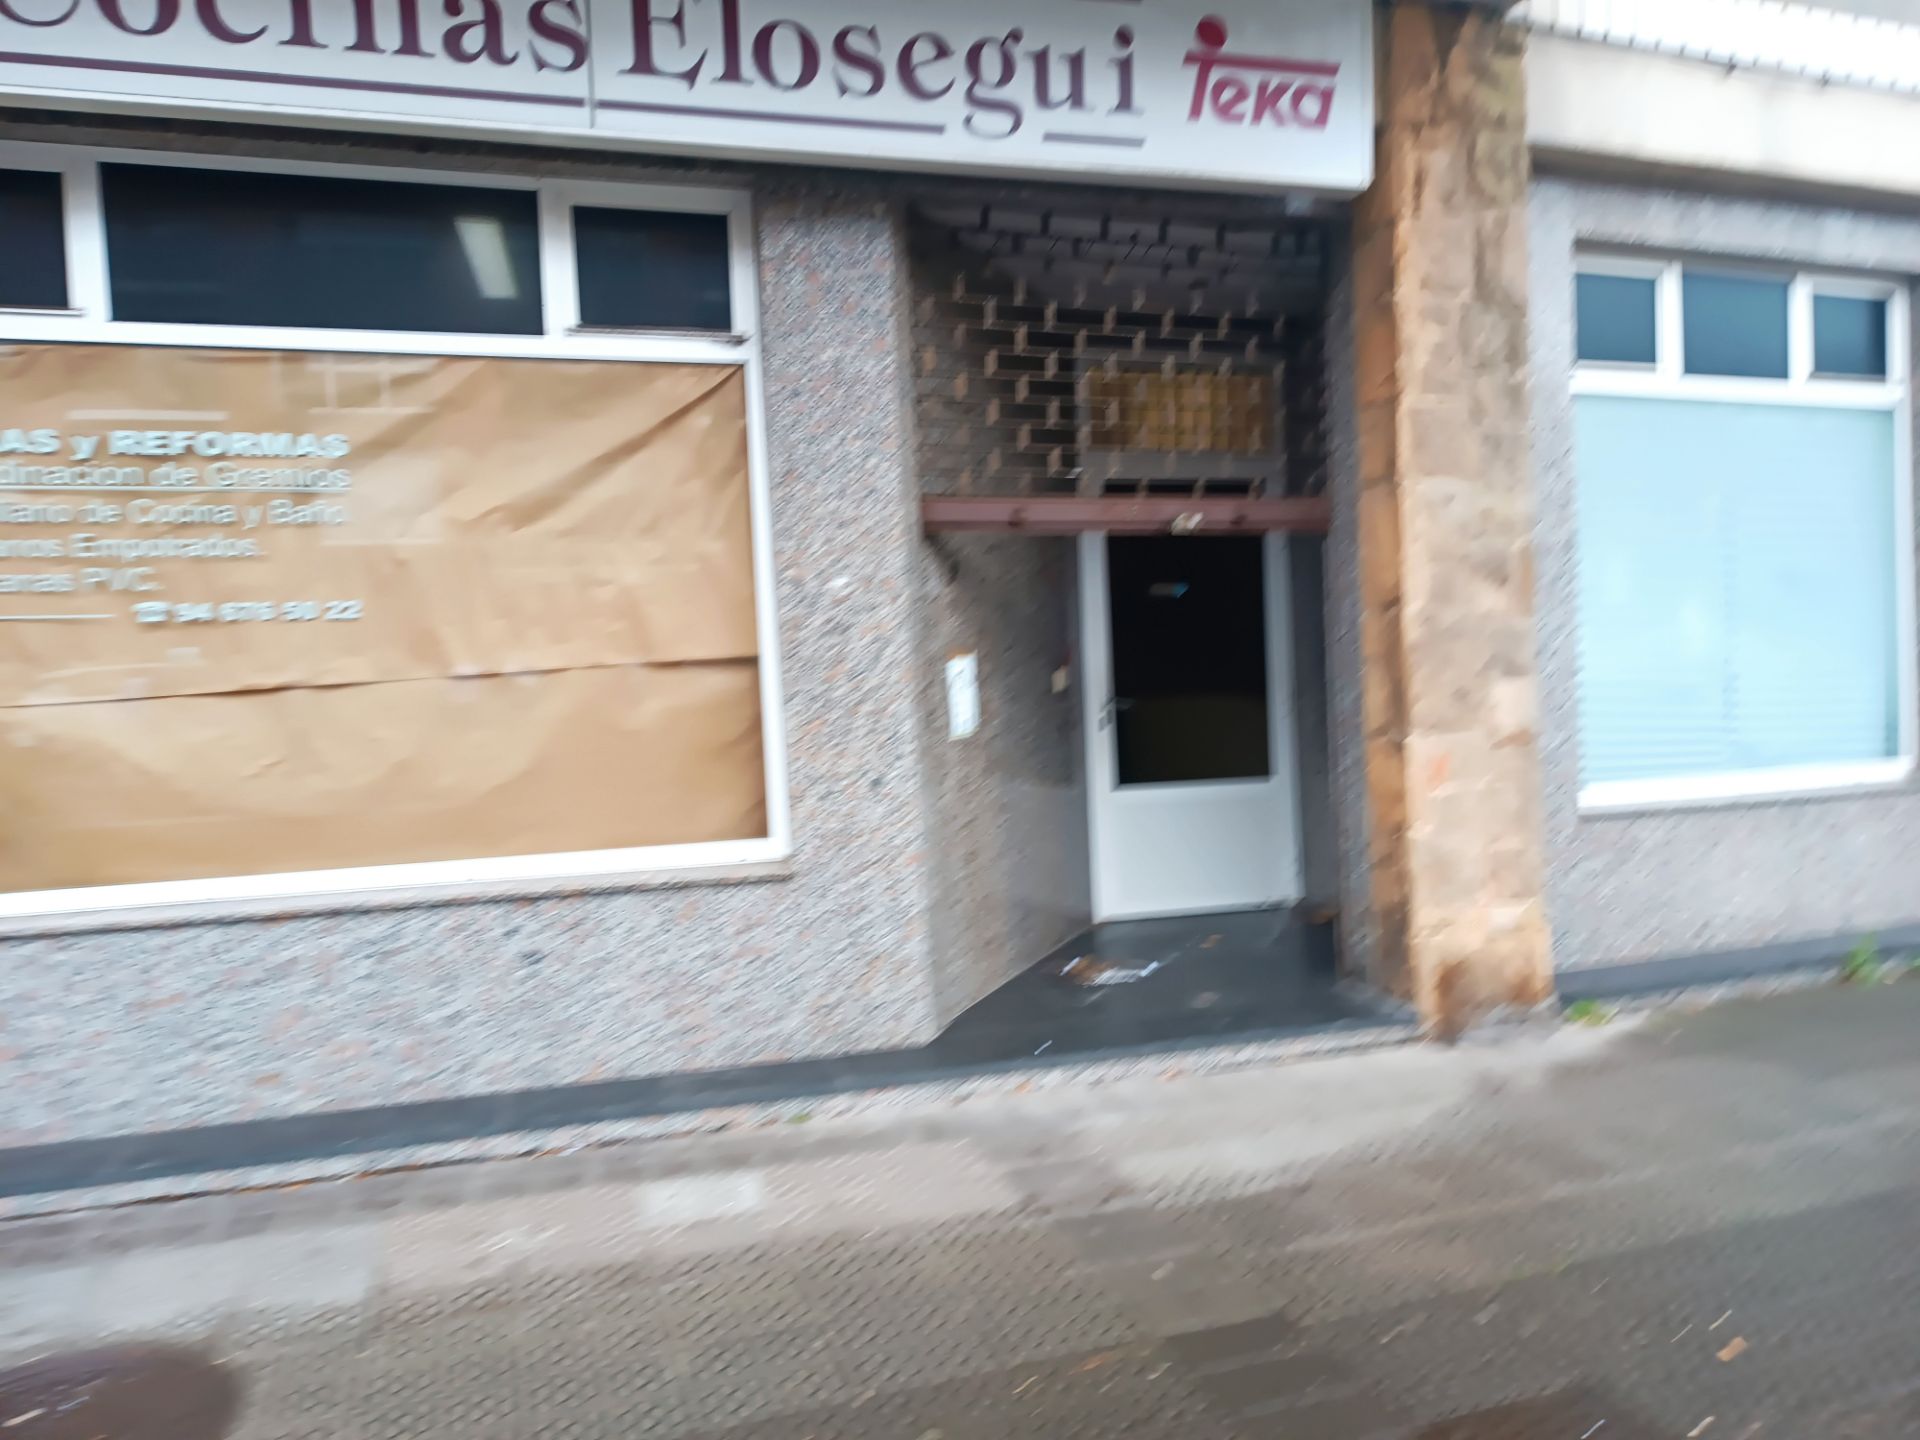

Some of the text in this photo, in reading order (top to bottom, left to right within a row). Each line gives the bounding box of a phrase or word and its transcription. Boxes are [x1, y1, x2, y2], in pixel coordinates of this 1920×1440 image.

[0, 0, 1145, 141] cinas Elosegui
[69, 434, 100, 460] y
[107, 429, 350, 458] REFORMAS
[149, 461, 199, 487] de
[202, 461, 352, 488] Gremios
[77, 499, 124, 524] de
[126, 498, 239, 525] Cocina
[240, 504, 264, 531] y
[323, 599, 366, 621] 22
